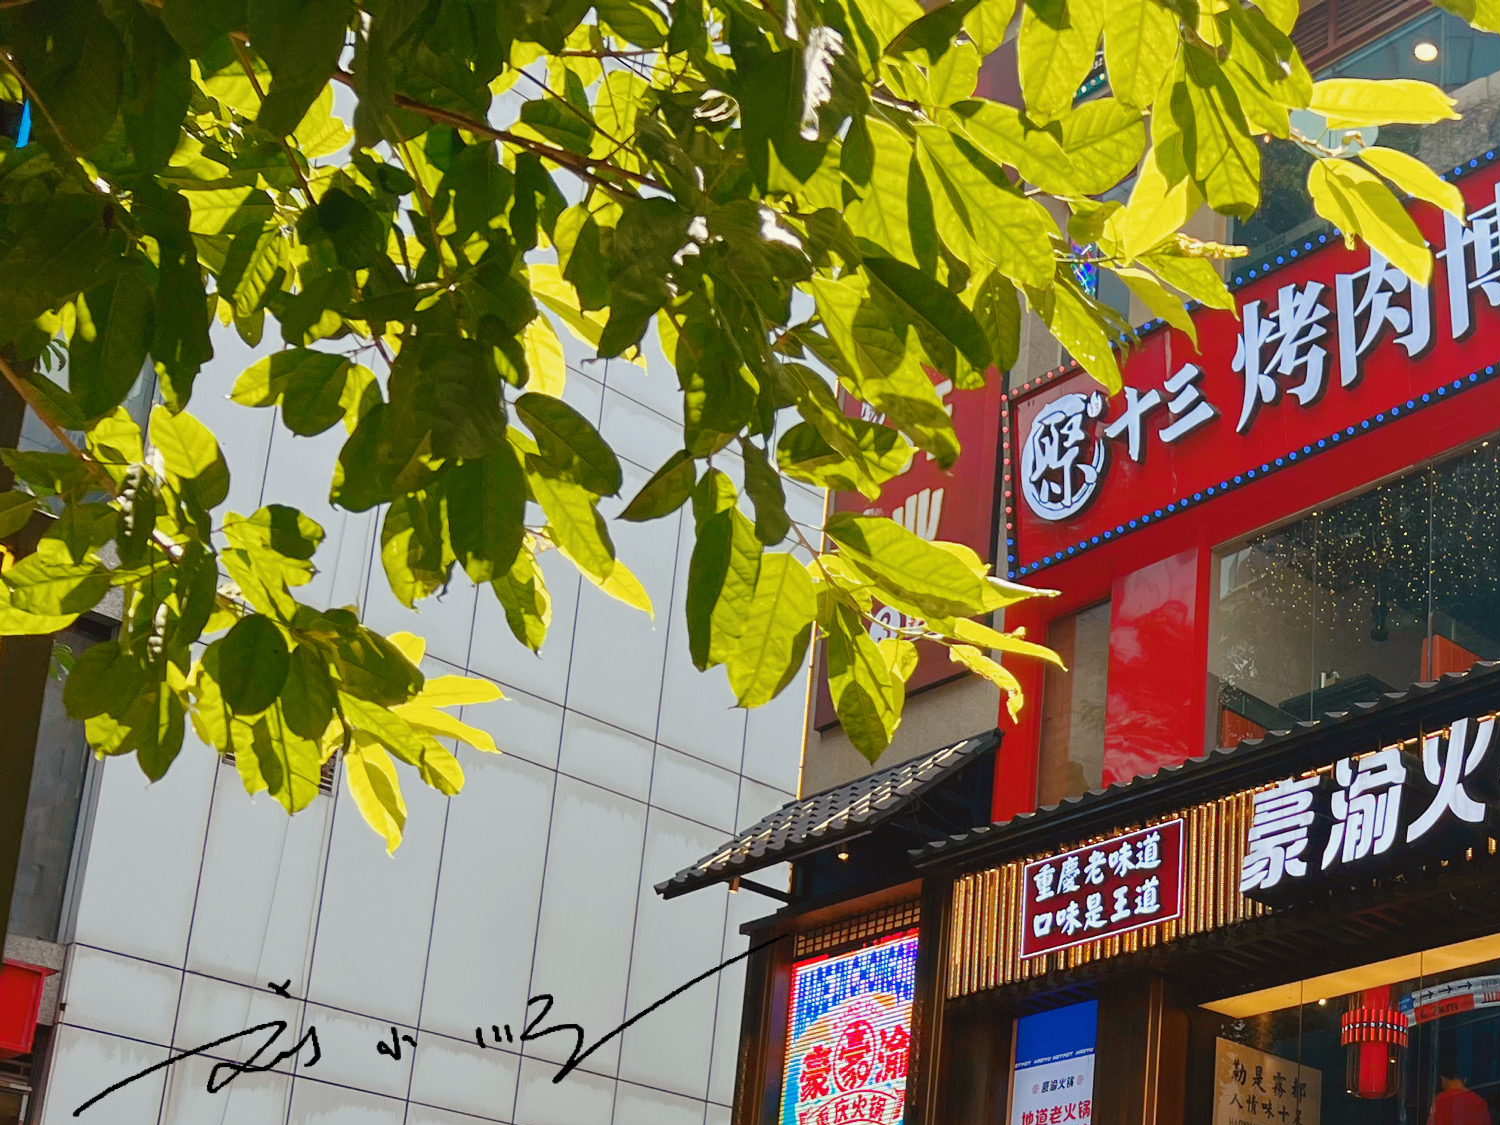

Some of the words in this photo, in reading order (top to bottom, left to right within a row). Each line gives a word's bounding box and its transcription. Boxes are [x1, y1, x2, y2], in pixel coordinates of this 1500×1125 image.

[1033, 830, 1162, 903] 重慶老味道
[1033, 875, 1161, 938] 口味是王道
